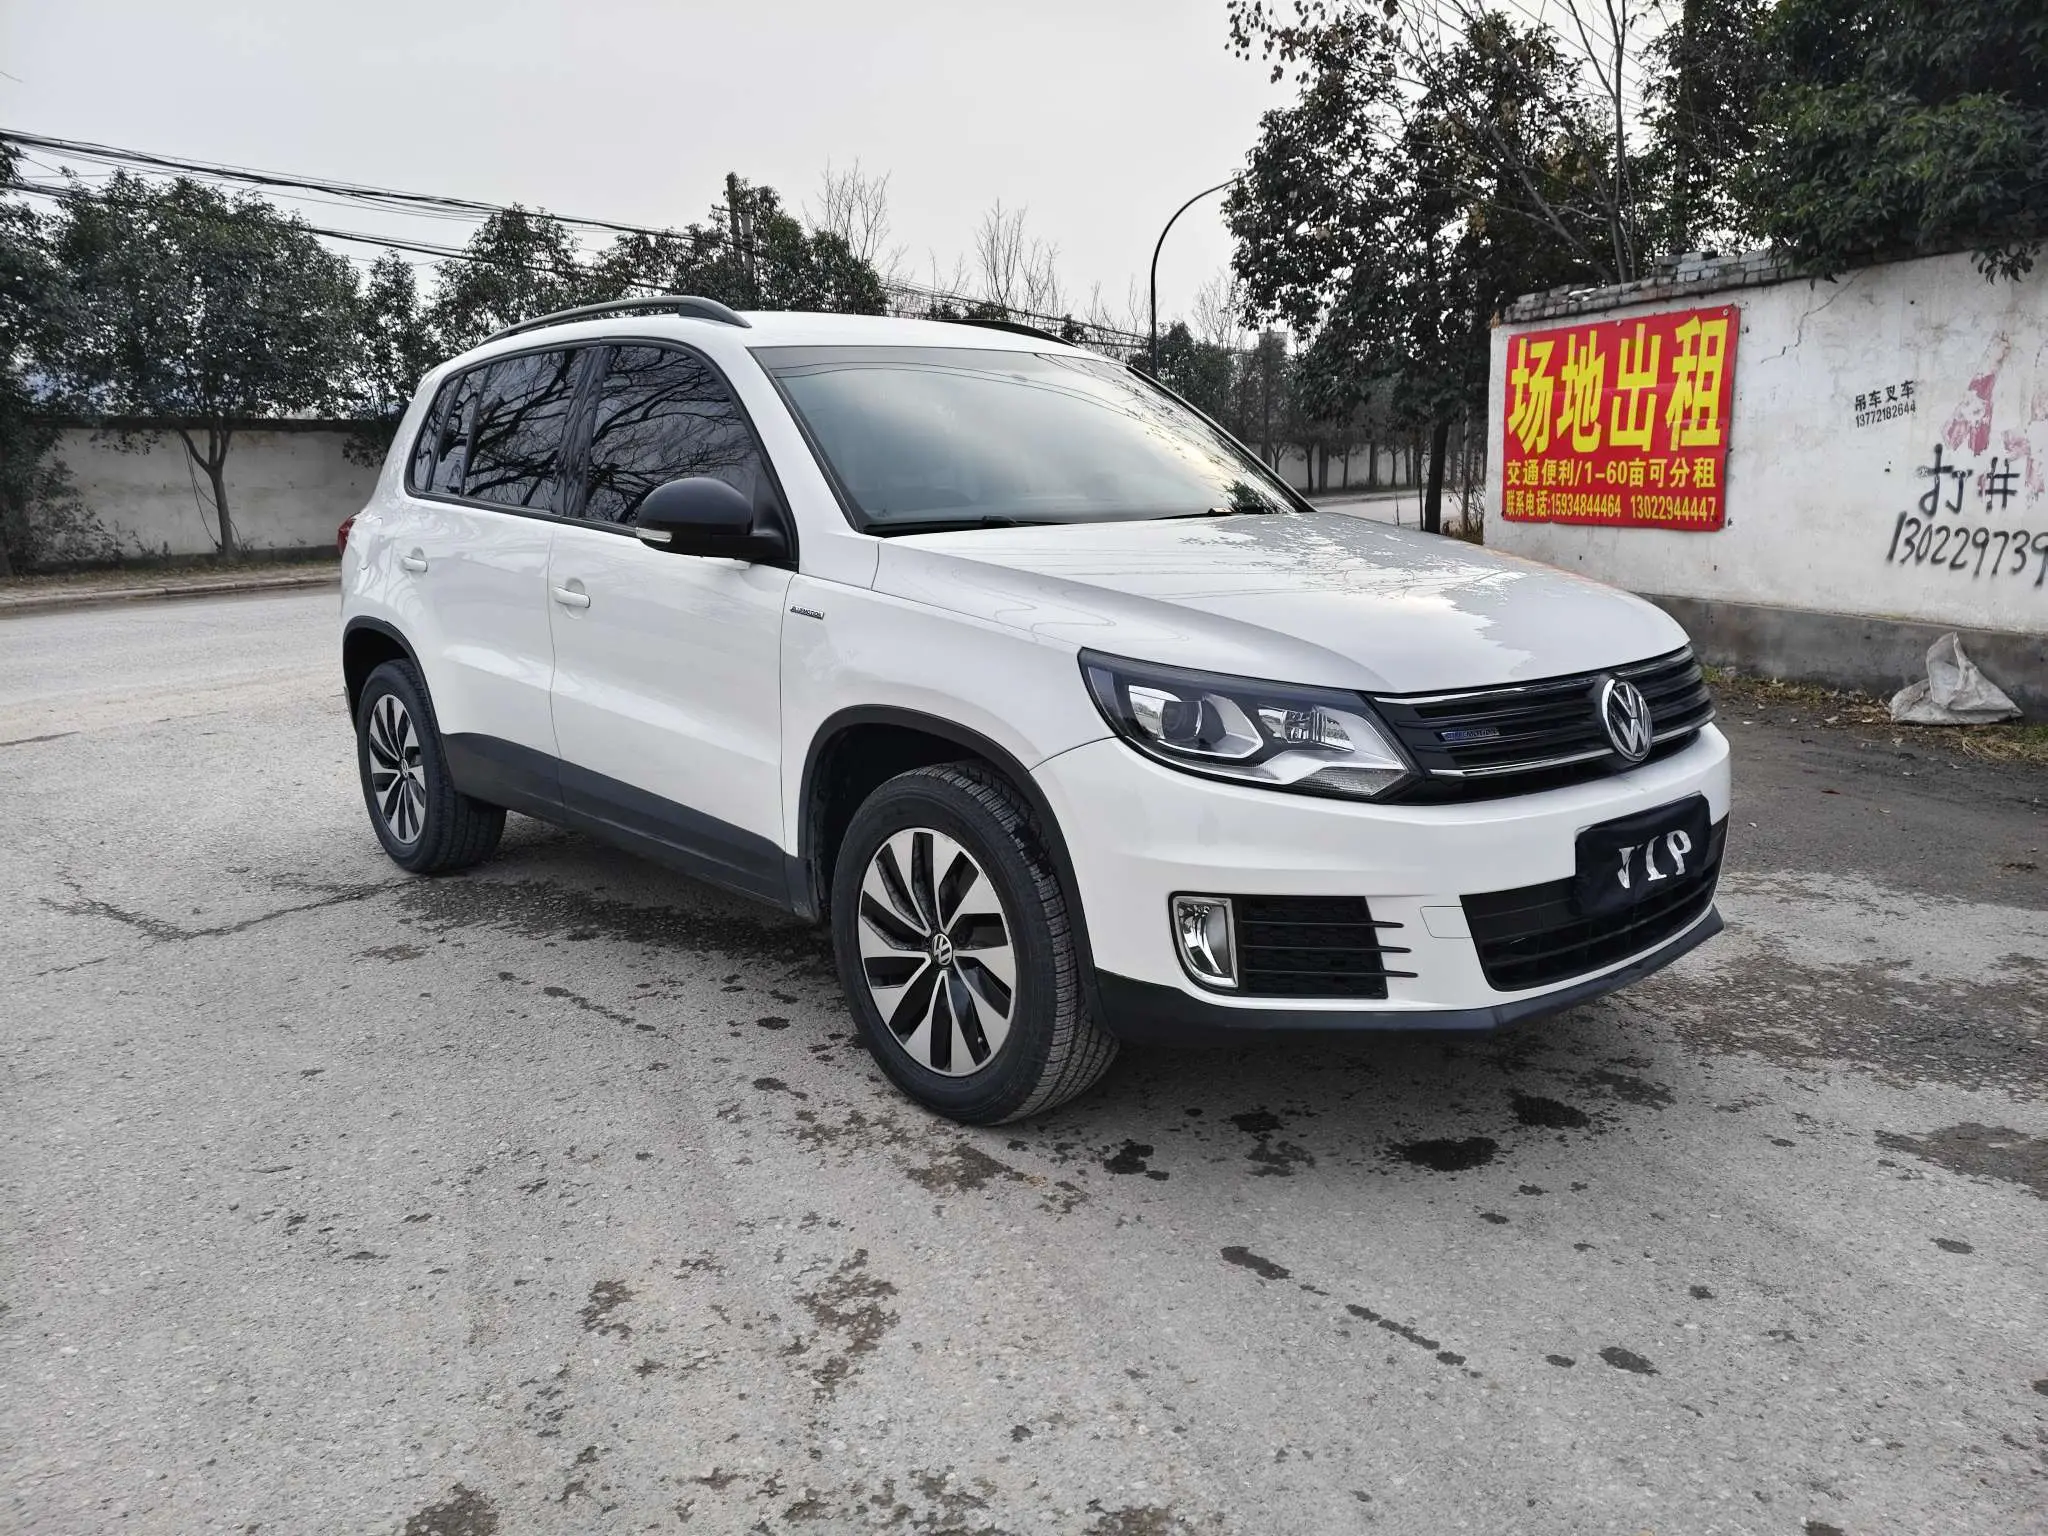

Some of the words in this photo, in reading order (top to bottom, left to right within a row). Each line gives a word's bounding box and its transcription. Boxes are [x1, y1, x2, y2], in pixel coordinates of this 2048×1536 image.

[1508, 316, 1729, 454] 场地出租
[1854, 380, 1915, 412] 吊车叉车
[1855, 400, 1916, 428] 13772182644
[1506, 457, 1716, 489] 交通便利/1-60亩可分租
[1918, 443, 2020, 518] 打井
[1630, 496, 1716, 522] 13022944447
